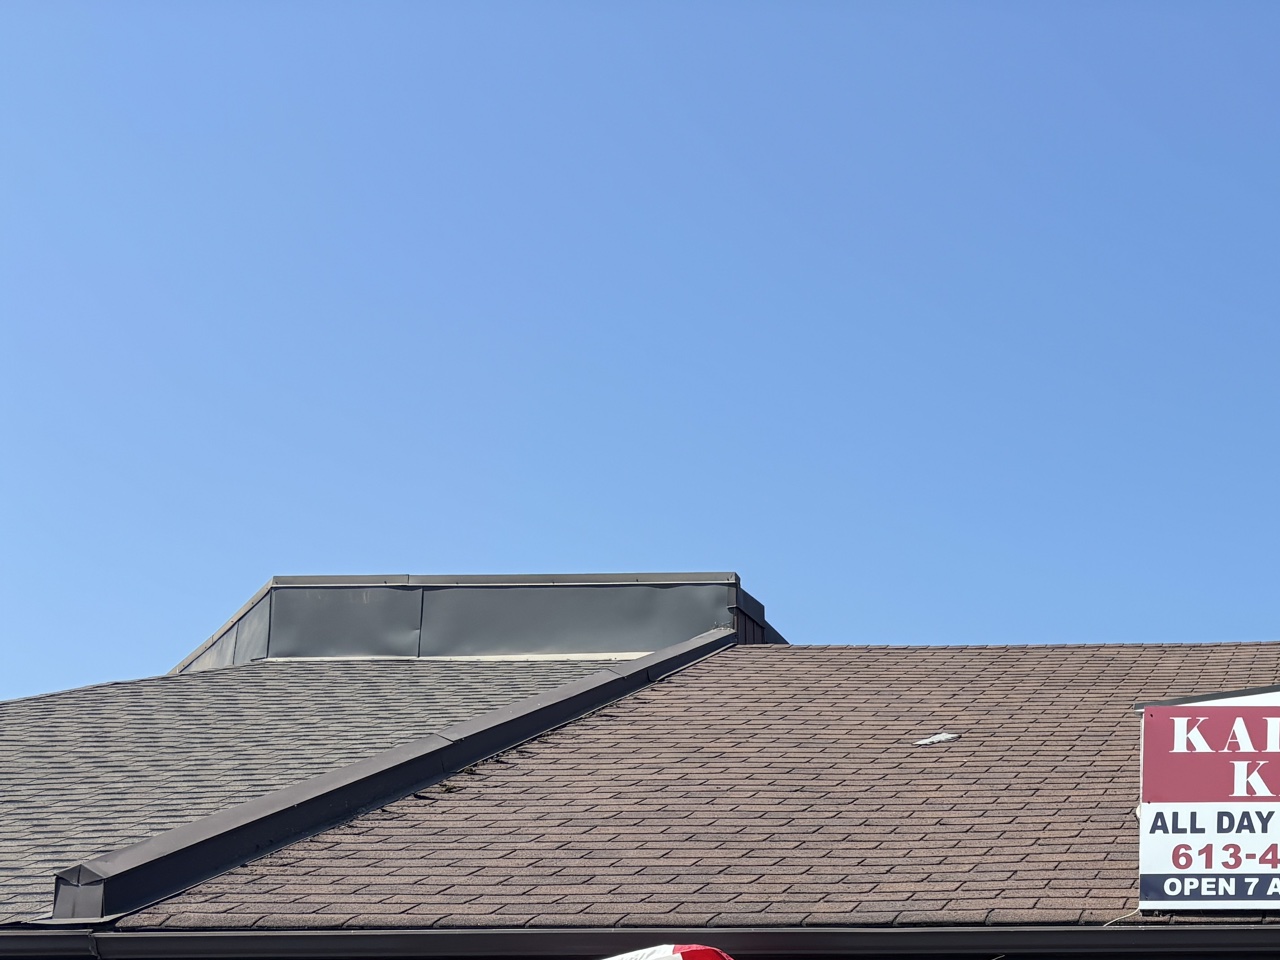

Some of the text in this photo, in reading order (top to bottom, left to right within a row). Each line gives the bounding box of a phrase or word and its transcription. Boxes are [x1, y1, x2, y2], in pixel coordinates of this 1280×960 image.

[1149, 811, 1206, 835] ALL
[1216, 811, 1276, 834] DAY
[1163, 877, 1236, 896] OPEN
[1244, 877, 1260, 896] 7
